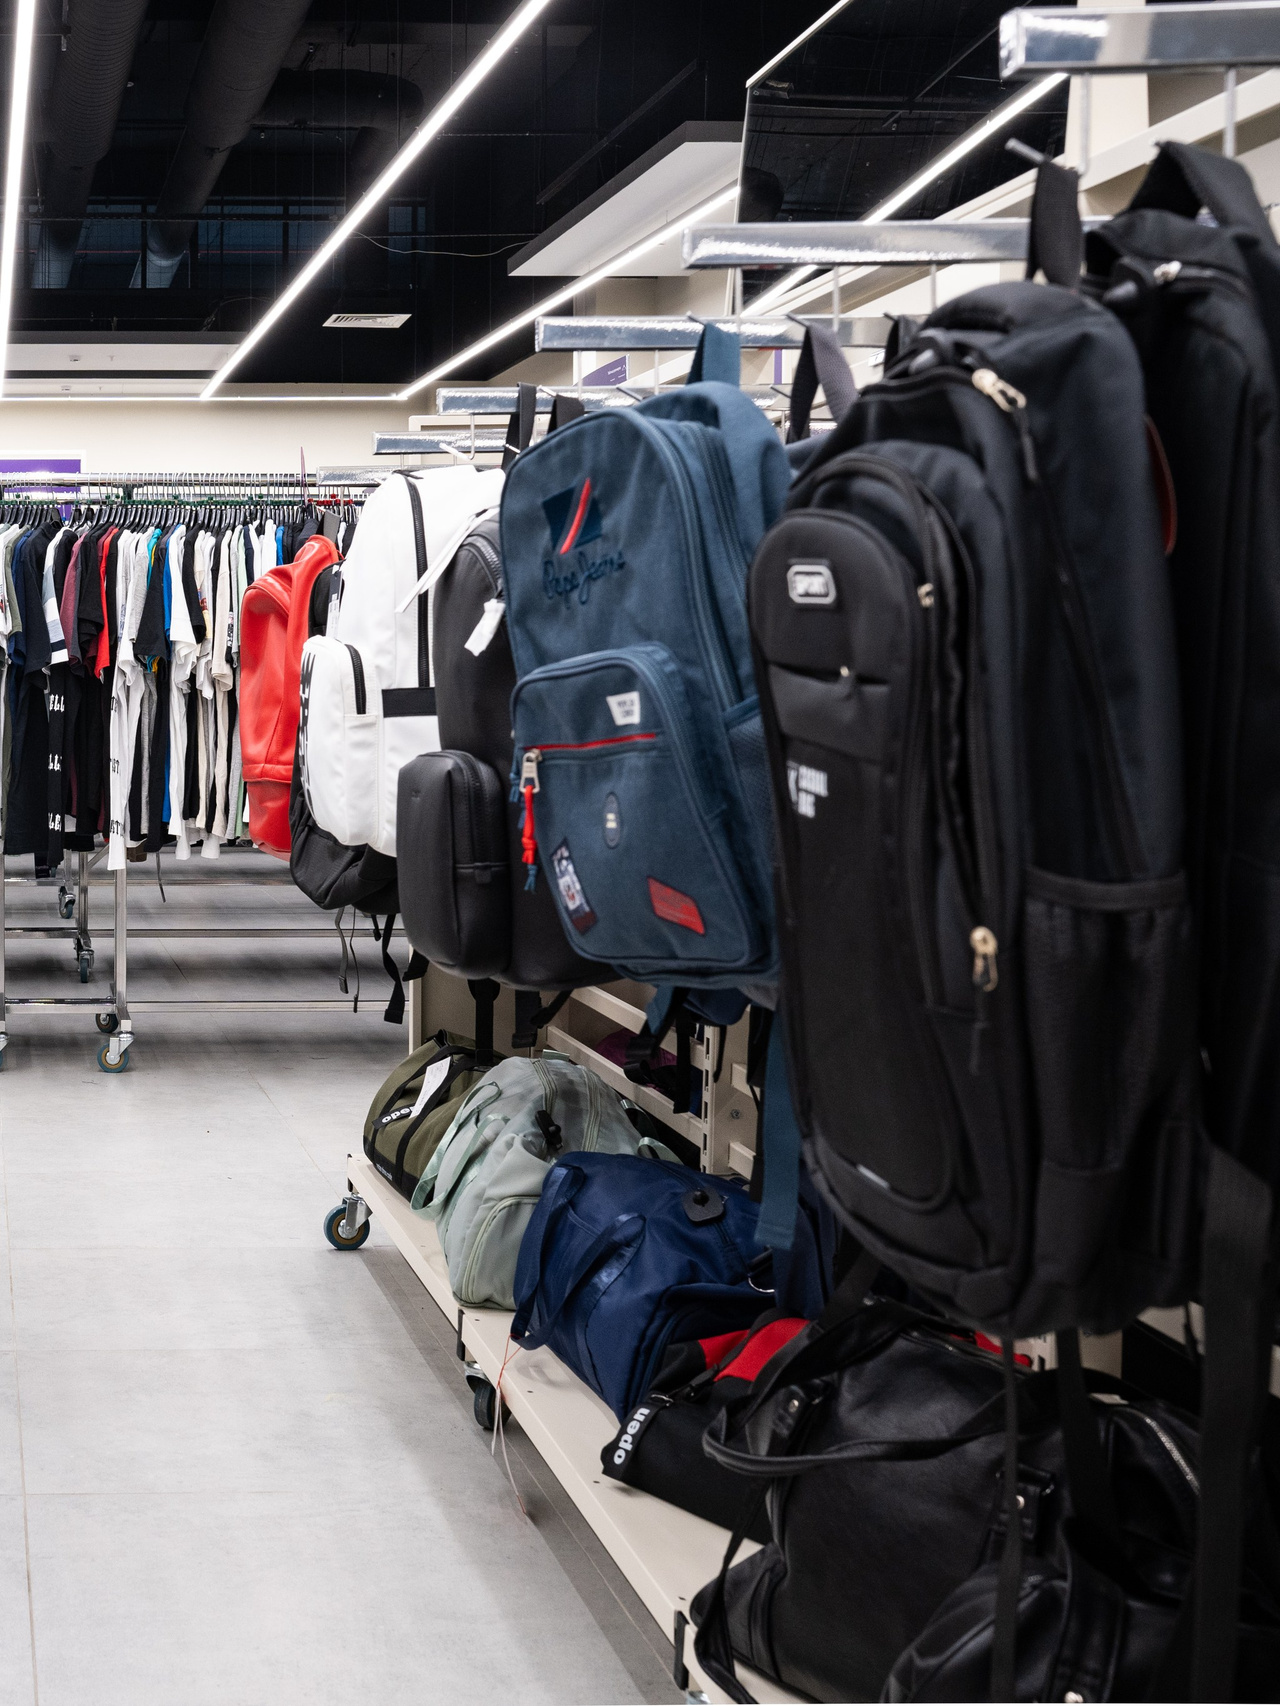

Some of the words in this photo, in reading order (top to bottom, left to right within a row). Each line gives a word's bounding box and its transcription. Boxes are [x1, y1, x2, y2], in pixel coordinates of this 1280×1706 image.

[543, 559, 580, 610] Pepe
[577, 550, 626, 605] Jeans
[613, 1407, 651, 1465] open
